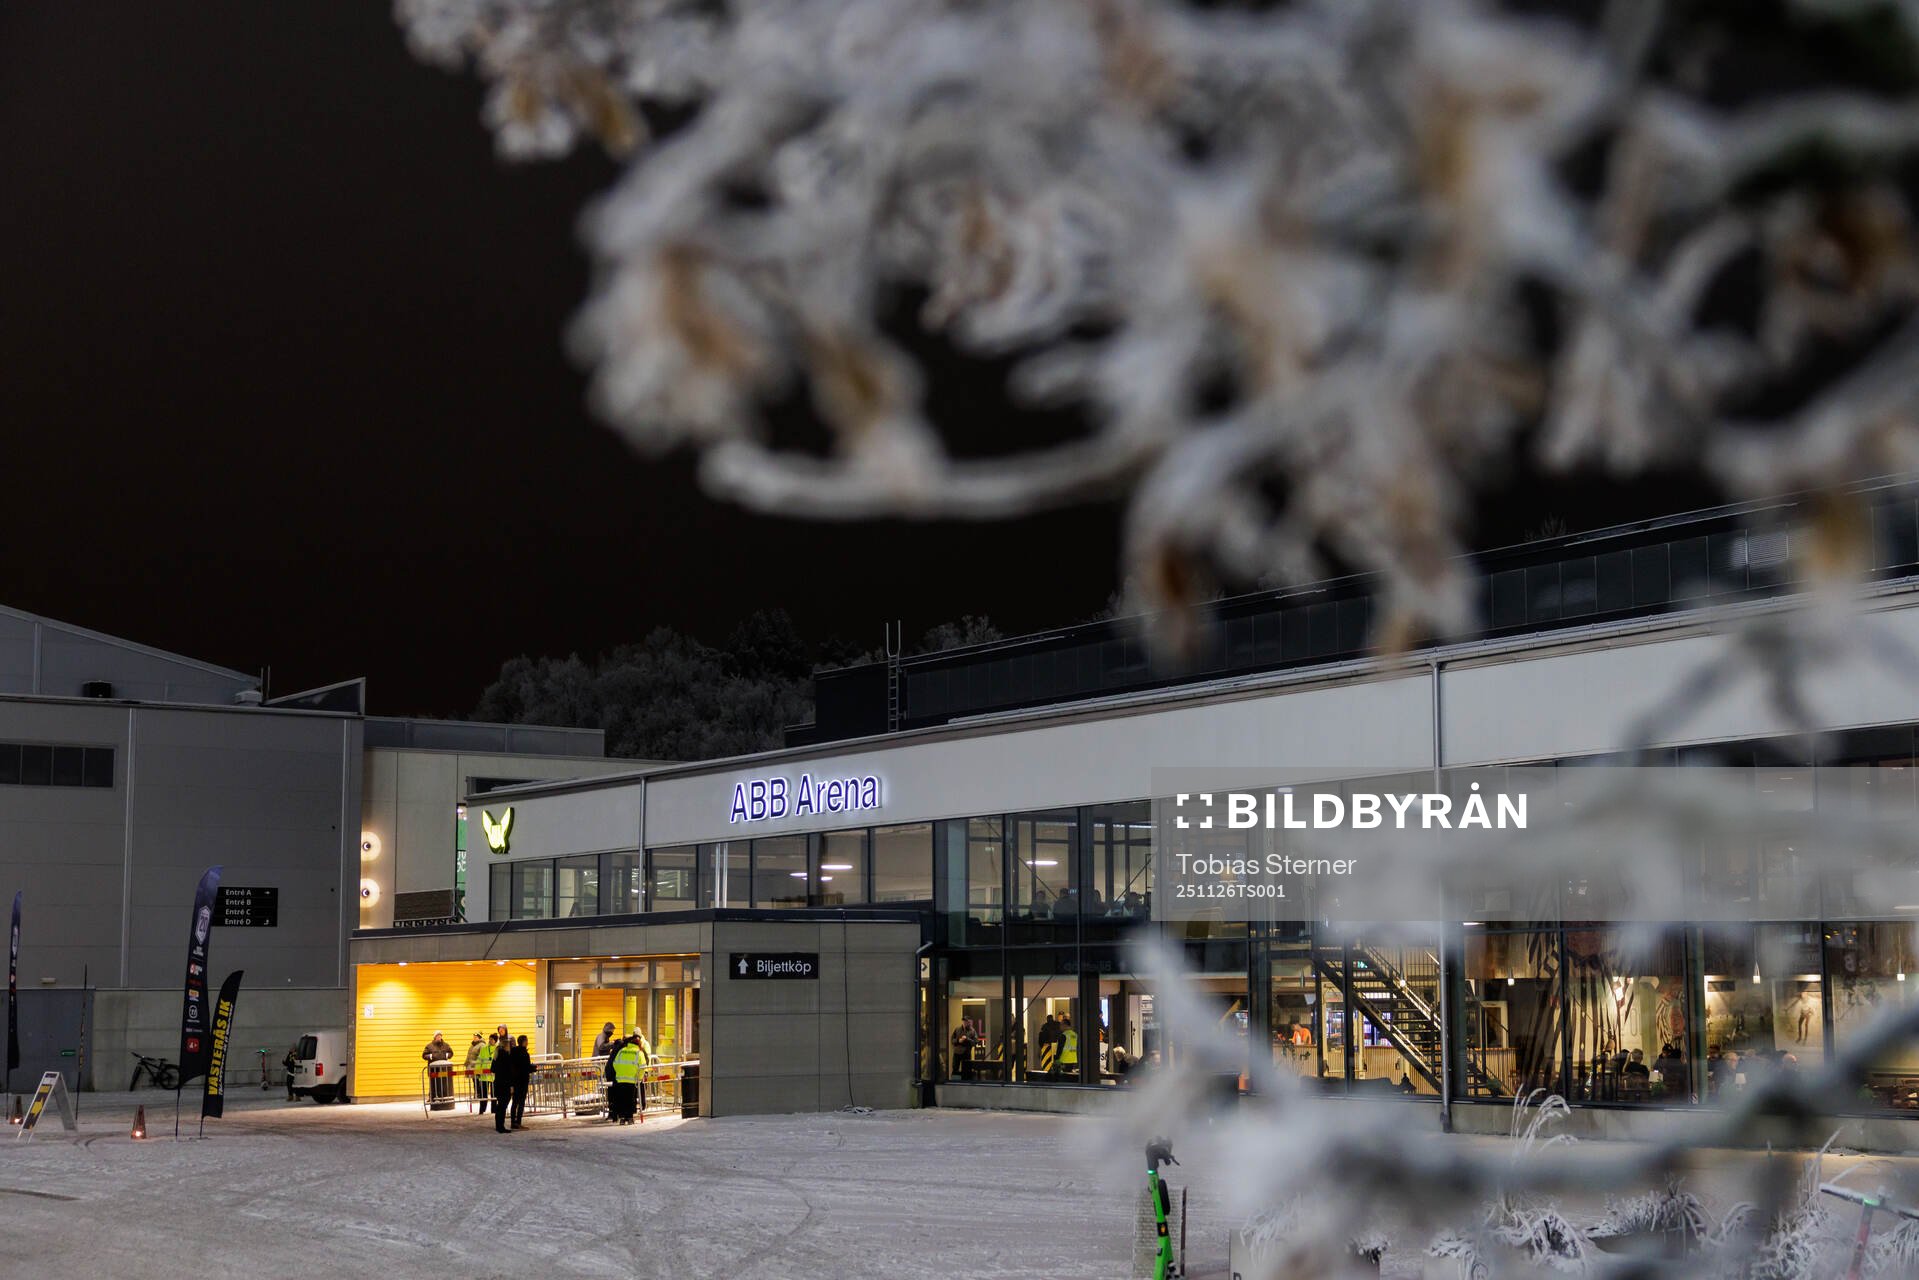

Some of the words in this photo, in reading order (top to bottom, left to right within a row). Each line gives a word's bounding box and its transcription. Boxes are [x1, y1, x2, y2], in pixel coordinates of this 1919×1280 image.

[730, 777, 788, 823] ABB
[795, 773, 880, 816] Arena
[757, 960, 812, 977] Biljettköp
[218, 999, 232, 1017] IK
